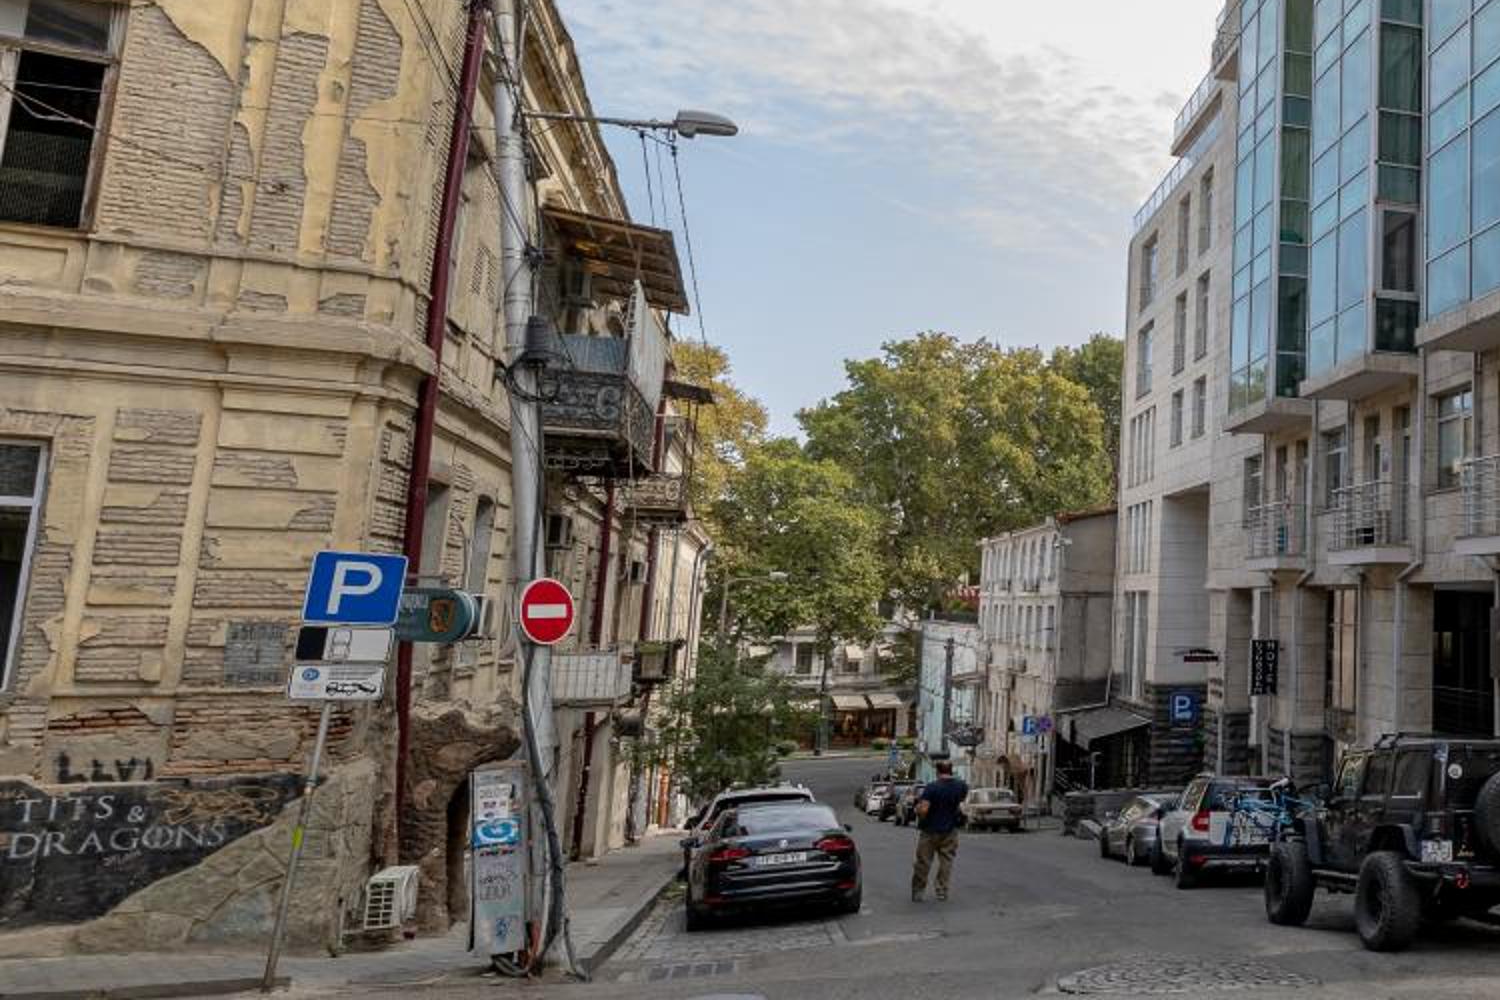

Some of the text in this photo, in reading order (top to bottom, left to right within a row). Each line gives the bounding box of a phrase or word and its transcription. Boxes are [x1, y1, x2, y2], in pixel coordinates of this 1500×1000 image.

[326, 561, 383, 615] P
[1175, 695, 1191, 713] P
[16, 794, 145, 823] TITS &
[8, 825, 225, 859] DRAGONS
